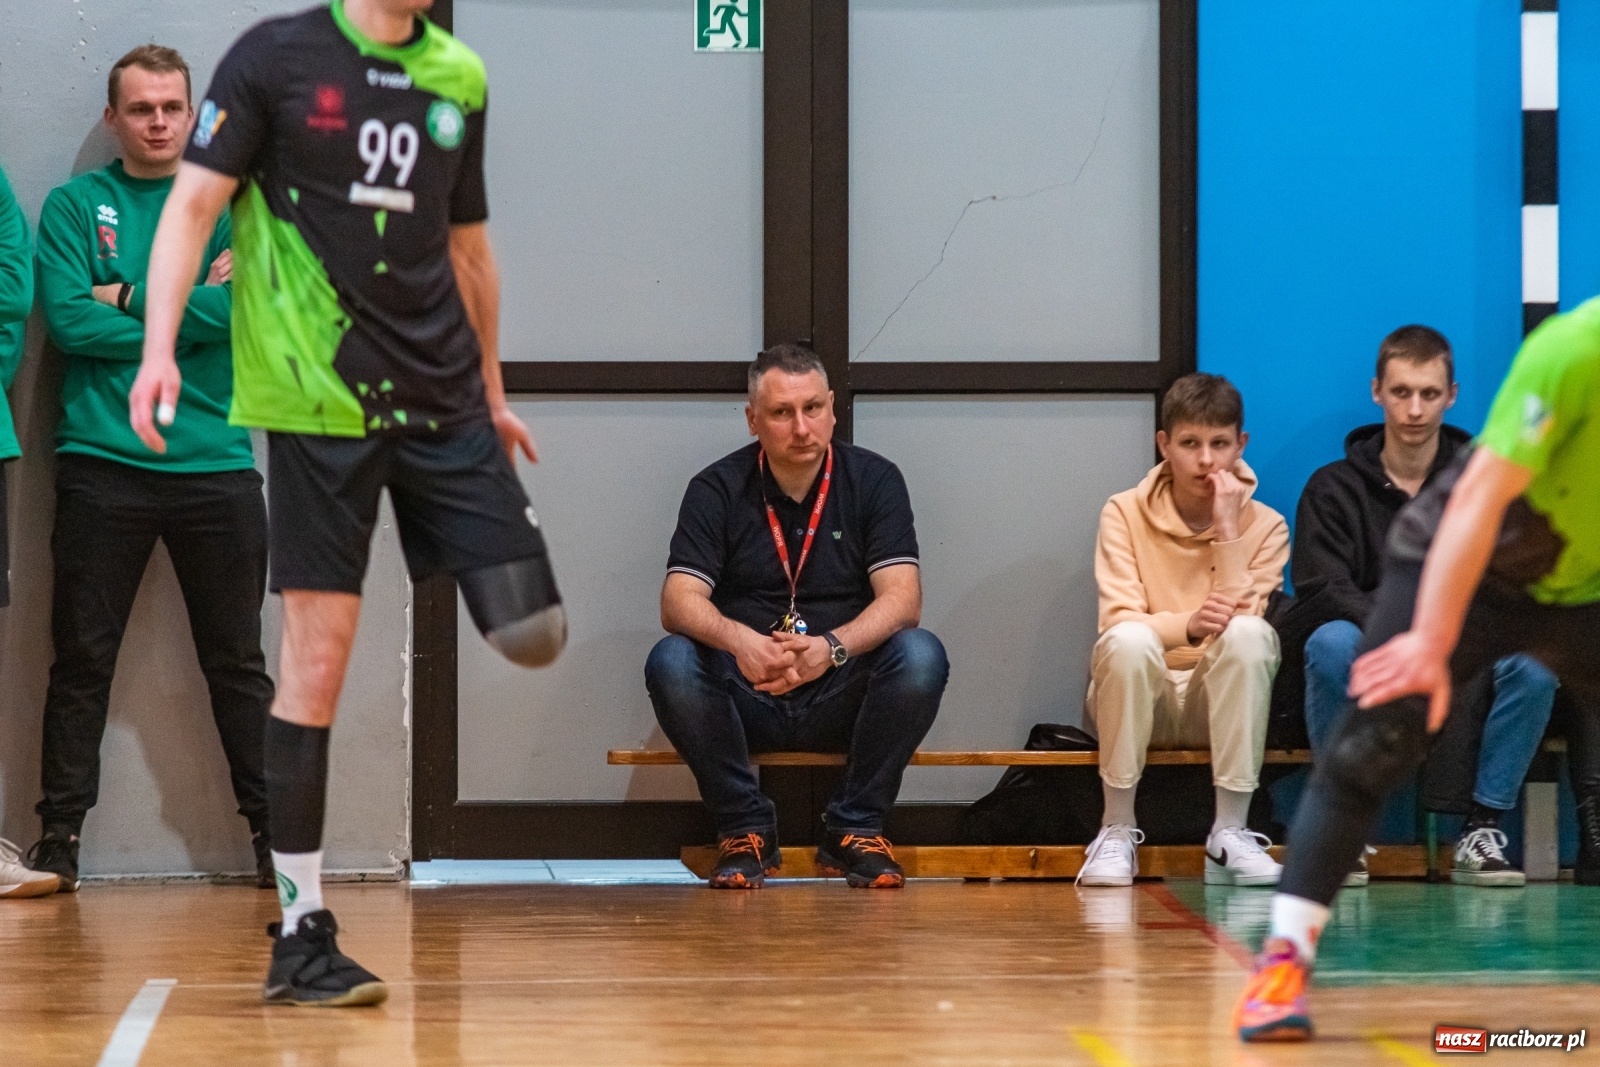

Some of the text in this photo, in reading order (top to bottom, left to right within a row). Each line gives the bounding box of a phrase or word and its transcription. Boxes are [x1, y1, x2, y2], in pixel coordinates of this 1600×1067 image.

[358, 118, 419, 188] 99
[814, 493, 825, 515] WOPR
[772, 525, 784, 548] WOPR
